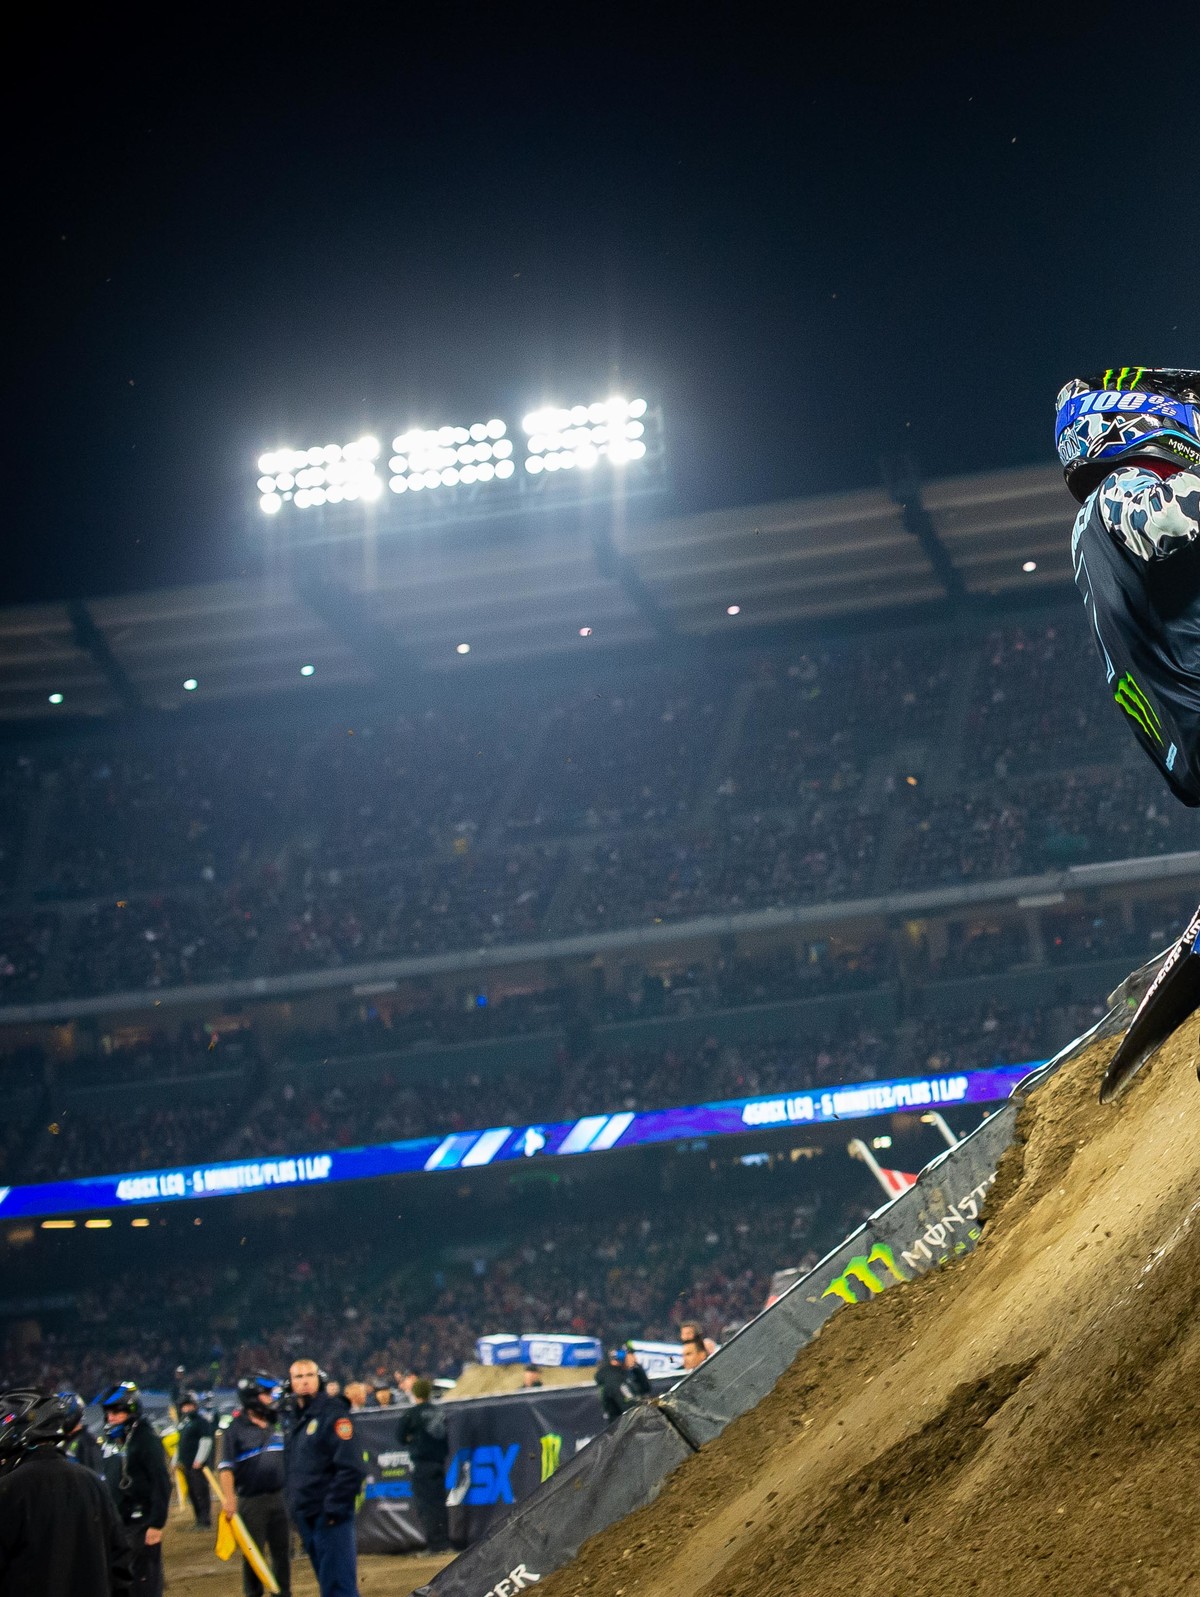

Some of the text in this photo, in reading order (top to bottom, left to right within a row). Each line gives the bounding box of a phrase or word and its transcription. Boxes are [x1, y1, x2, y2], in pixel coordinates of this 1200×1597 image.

[1079, 391, 1179, 416] 100%
[939, 1076, 968, 1101] LAP
[306, 1154, 332, 1180] LAP
